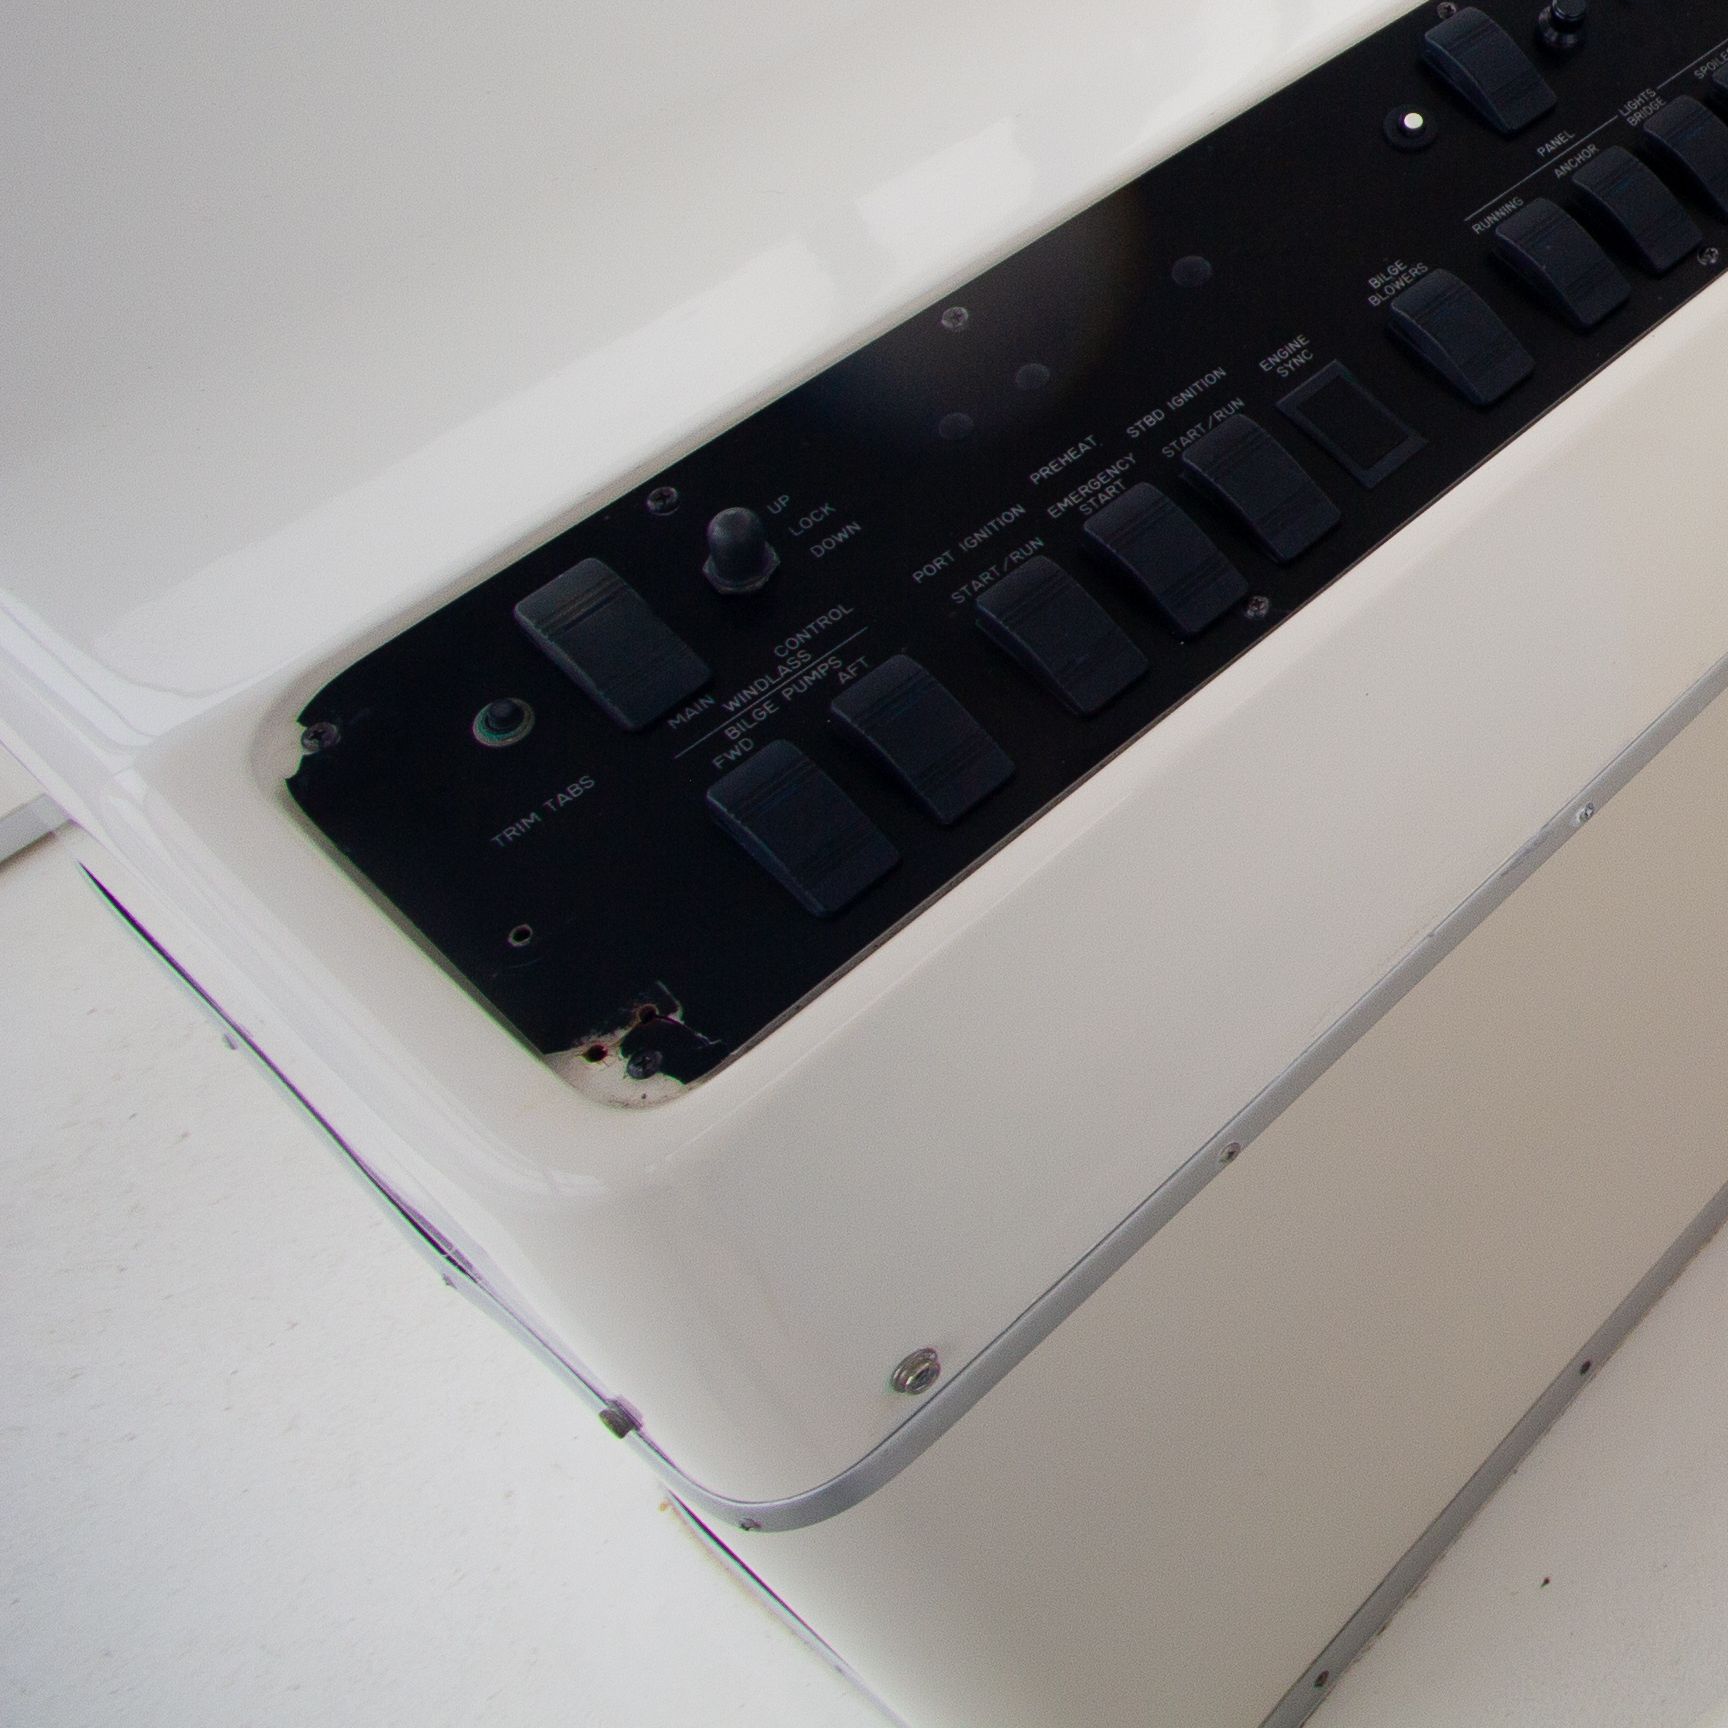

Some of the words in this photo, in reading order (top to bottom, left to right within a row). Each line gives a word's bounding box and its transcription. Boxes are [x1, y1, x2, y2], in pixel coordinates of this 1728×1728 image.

[1617, 87, 1657, 118] LIGHTS
[1625, 96, 1667, 128] BRIDGE
[1536, 129, 1576, 159] PANEL
[1552, 143, 1600, 180] ANCHOR
[1471, 195, 1525, 235] RUNNING
[1367, 261, 1430, 307] BLOWERS
[1368, 258, 1408, 291] BILGE
[1258, 333, 1311, 373] ENGINE
[1276, 348, 1315, 378] SYNC
[1125, 408, 1166, 440] STBD
[1166, 365, 1228, 413] IGNITION
[1028, 434, 1099, 486] PREHEAT
[766, 493, 792, 516] UP
[1046, 451, 1138, 521] EMERGENCY
[1078, 478, 1127, 518] START
[787, 502, 837, 538] LOCK
[808, 520, 863, 560] DOWN
[911, 549, 956, 586] PORT
[959, 503, 1027, 554] IGNITION
[772, 603, 855, 660] CONTROL
[721, 648, 813, 715] WINDLASS
[837, 655, 870, 687] AFT
[666, 693, 717, 731] MAIN
[723, 698, 781, 742] BILGE
[781, 654, 844, 702] PUMPS
[711, 736, 755, 771] FWD
[489, 810, 544, 850] TRIM
[542, 774, 597, 813] TABS
